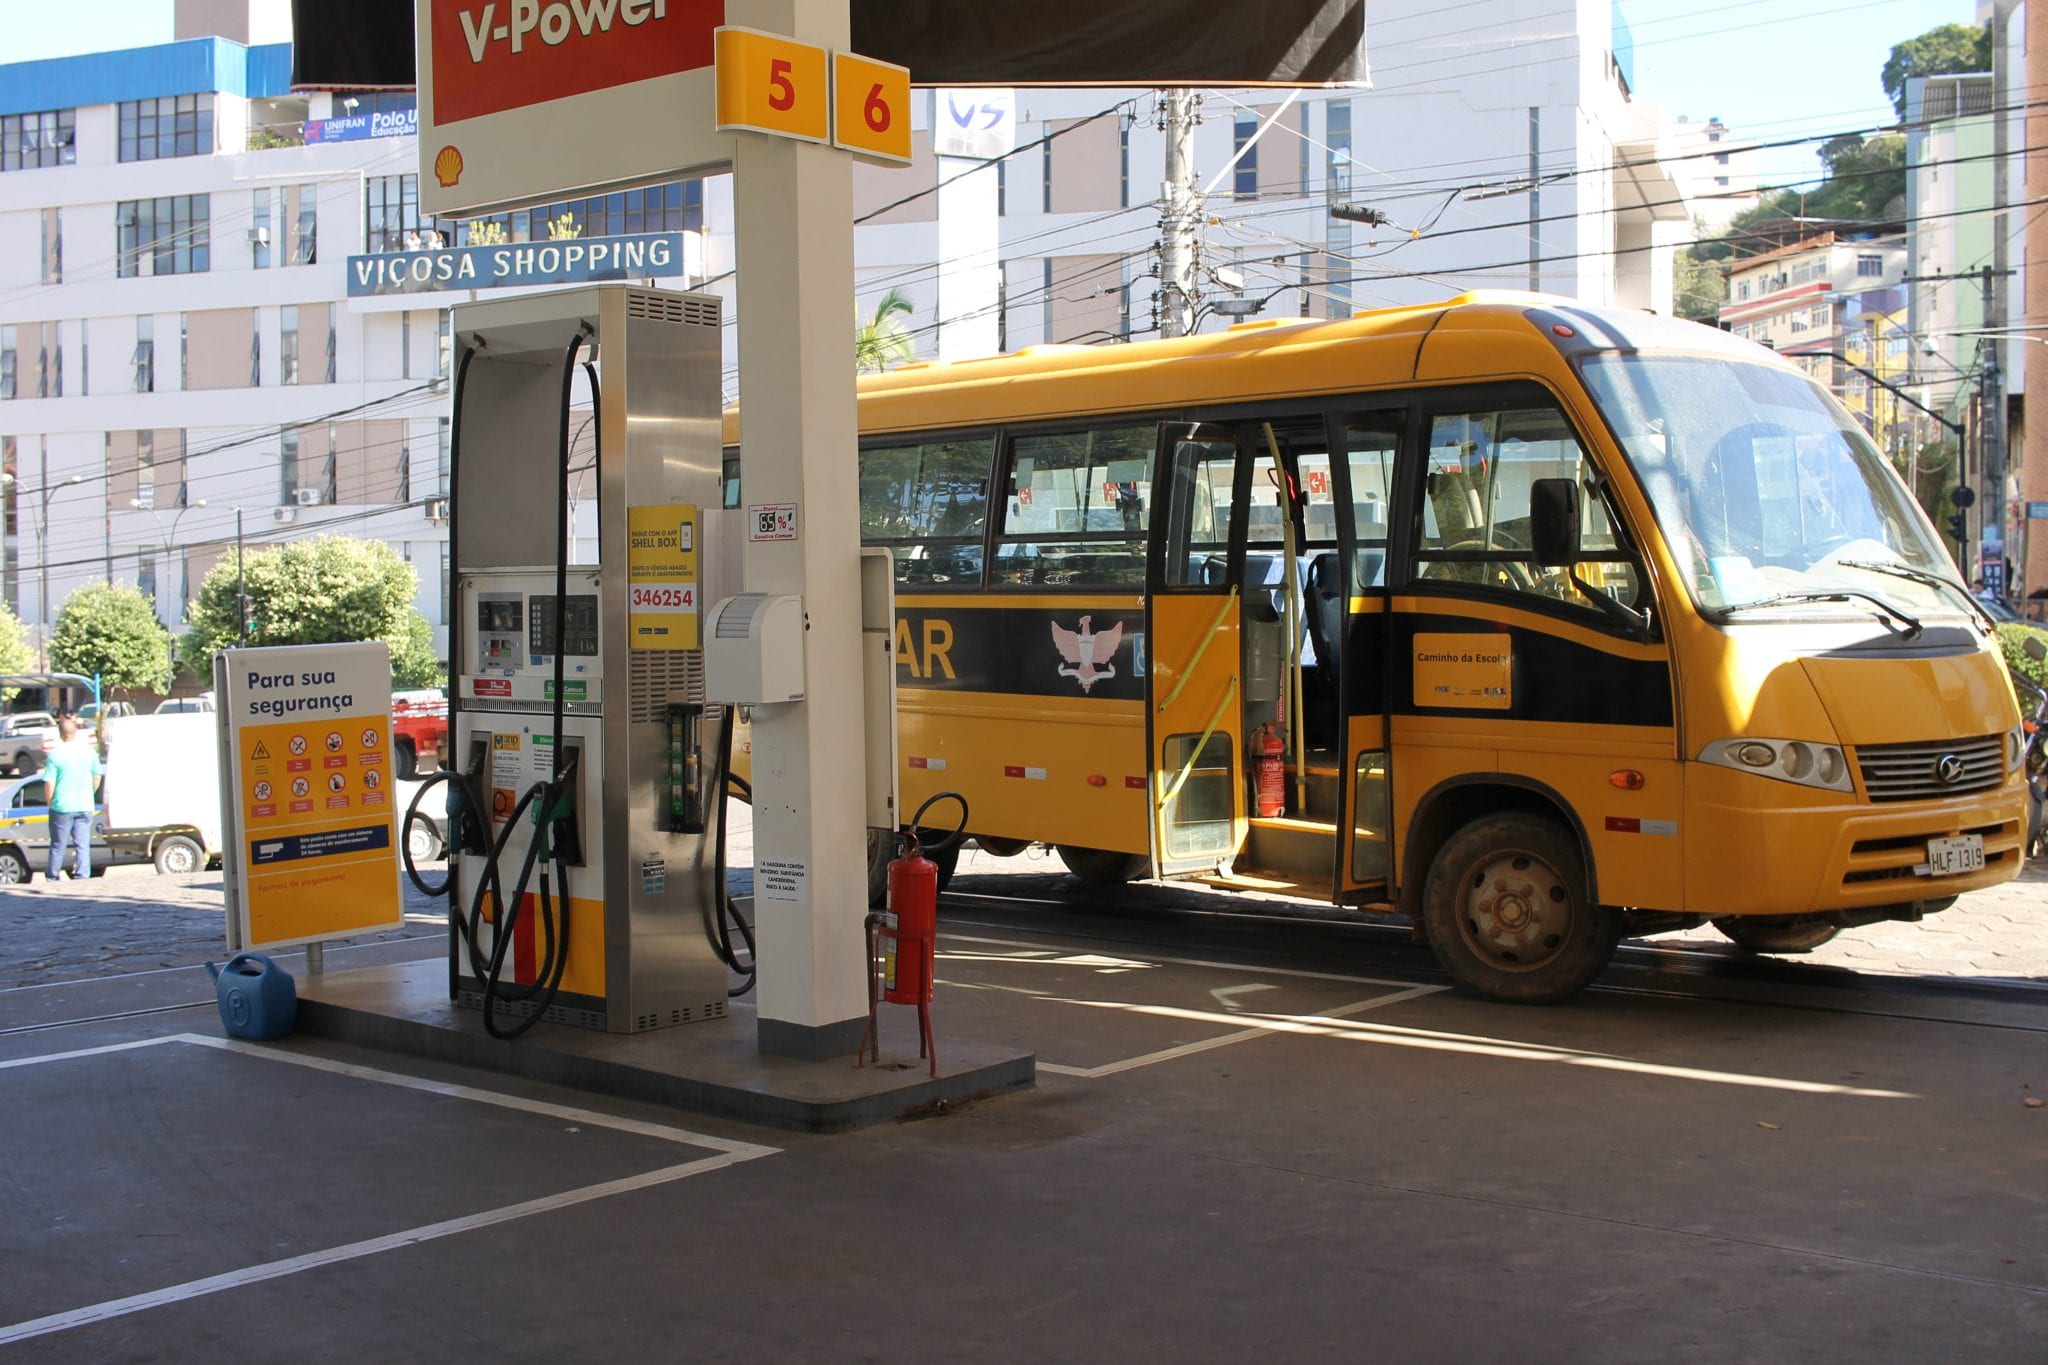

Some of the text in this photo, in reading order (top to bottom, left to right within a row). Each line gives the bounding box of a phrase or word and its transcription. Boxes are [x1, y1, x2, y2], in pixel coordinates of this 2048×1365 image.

[767, 59, 795, 112] 5
[863, 82, 891, 133] 6
[324, 117, 366, 131] UNIFRAN
[372, 111, 405, 128] Polo
[371, 123, 415, 137] Educação
[355, 239, 670, 288] VIÇOSA SHOPPING
[760, 513, 775, 531] 65
[631, 538, 678, 549] SHELL BOX
[633, 588, 693, 607] 346254
[1417, 652, 1507, 663] Caminho da Escola
[247, 671, 336, 690] Para sua
[249, 692, 354, 718] segurança
[257, 873, 346, 893] Formas de pagamento
